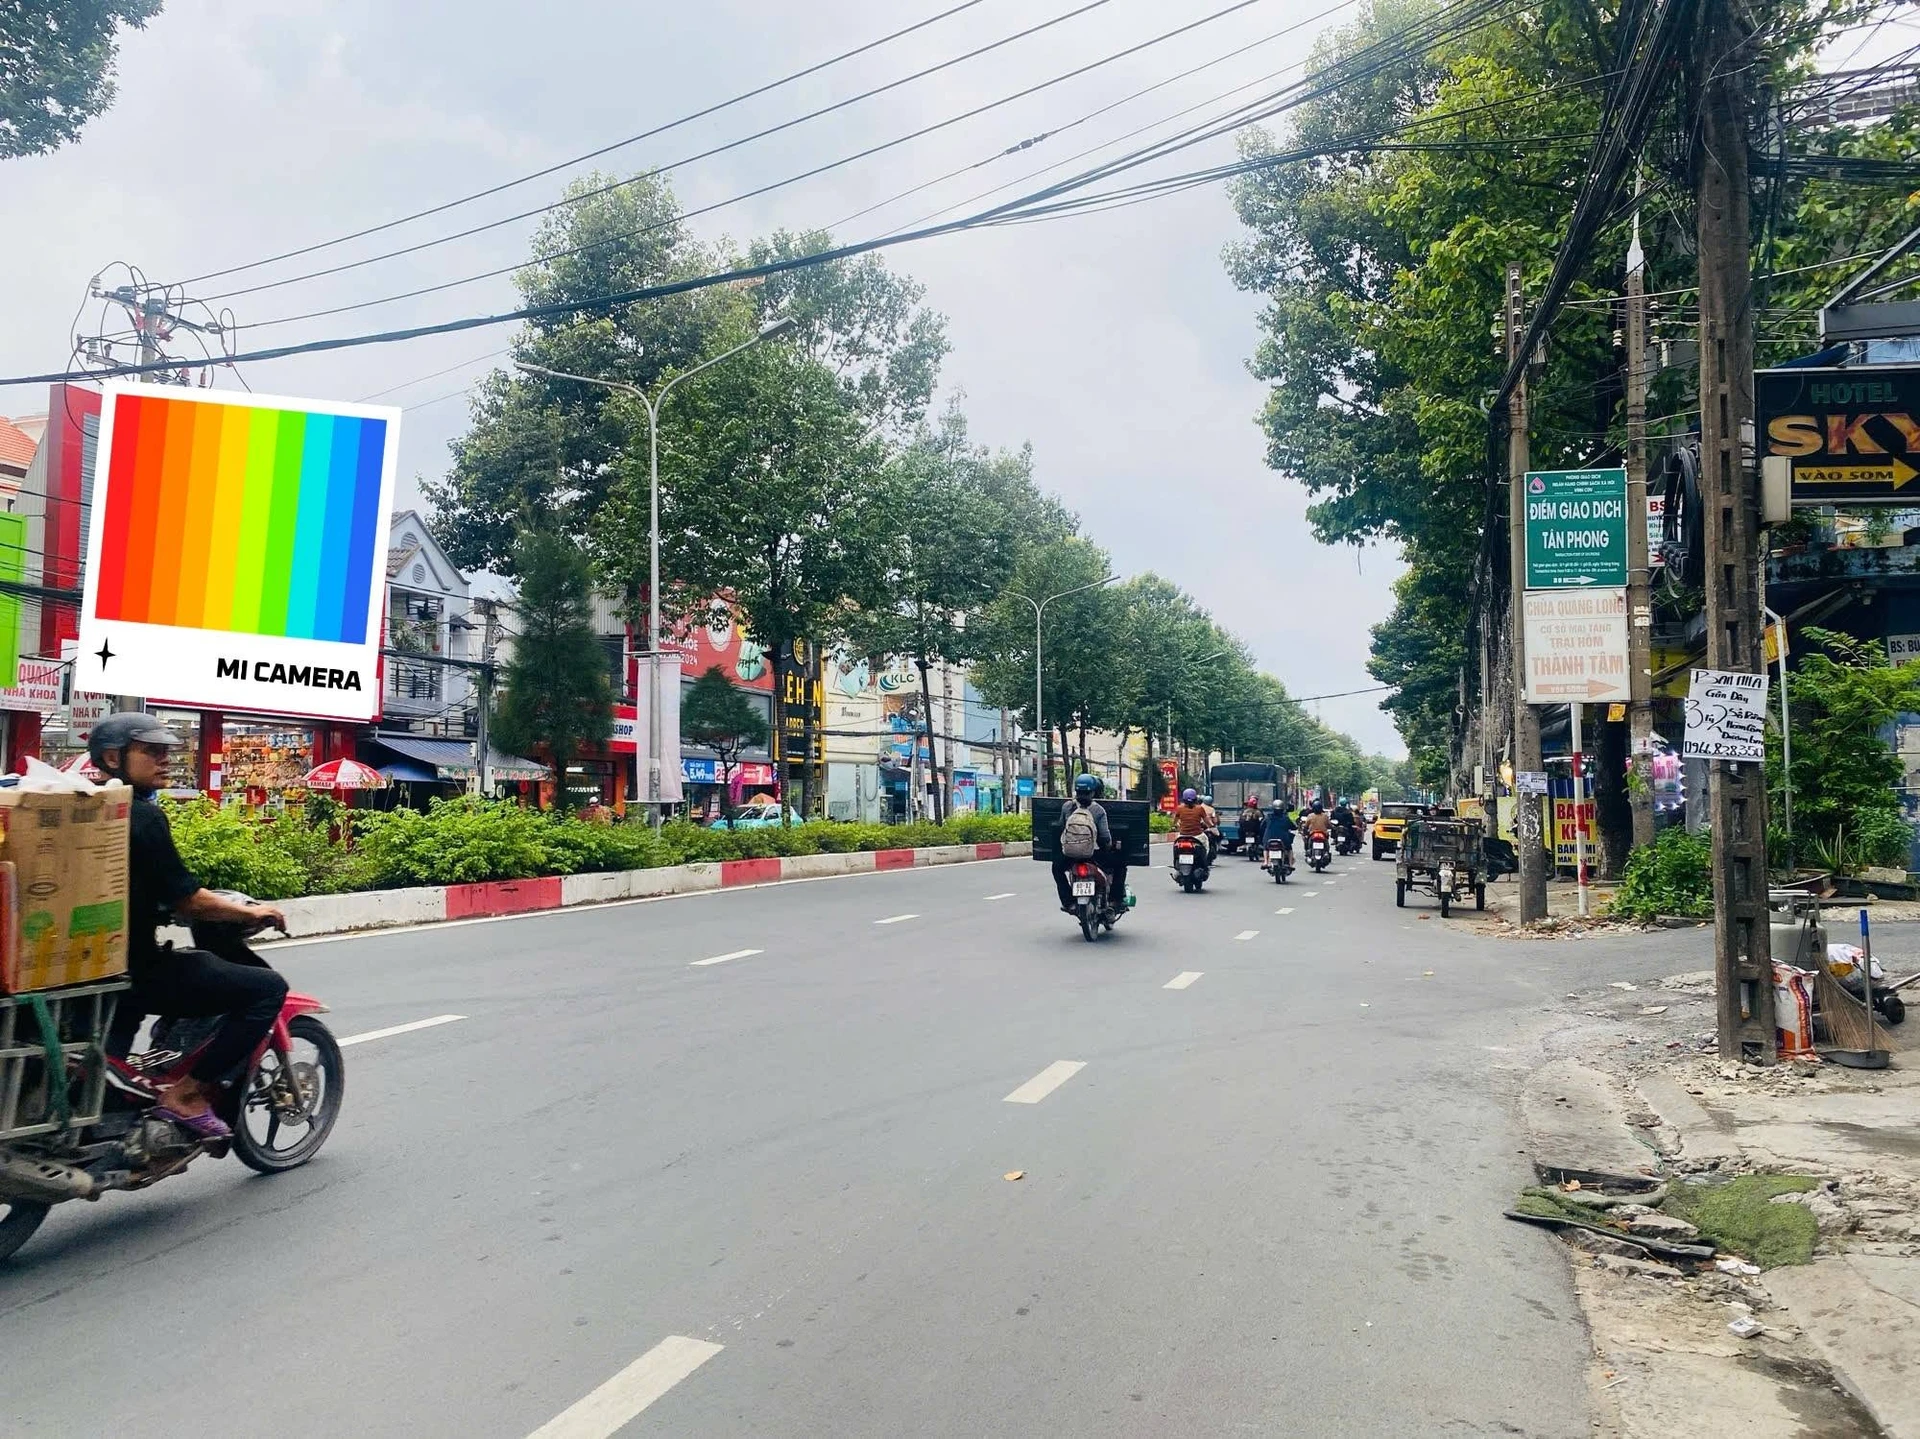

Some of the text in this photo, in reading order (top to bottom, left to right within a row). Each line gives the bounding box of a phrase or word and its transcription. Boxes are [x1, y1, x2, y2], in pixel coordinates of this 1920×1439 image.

[1811, 382, 1899, 404] HOTEL
[1768, 413, 1920, 457] SKY
[1559, 501, 1590, 519] GIAO
[1592, 500, 1621, 521] DỊCH
[1542, 529, 1609, 549] TÂN PHONG
[1558, 599, 1592, 617] QUANG
[1596, 598, 1624, 614] LONG
[1589, 651, 1624, 675] TÂM
[18, 663, 60, 687] QUANG
[891, 673, 915, 683] KLC
[29, 688, 57, 700] KHOA
[72, 707, 90, 718] NHA
[1556, 803, 1594, 820] BAH
